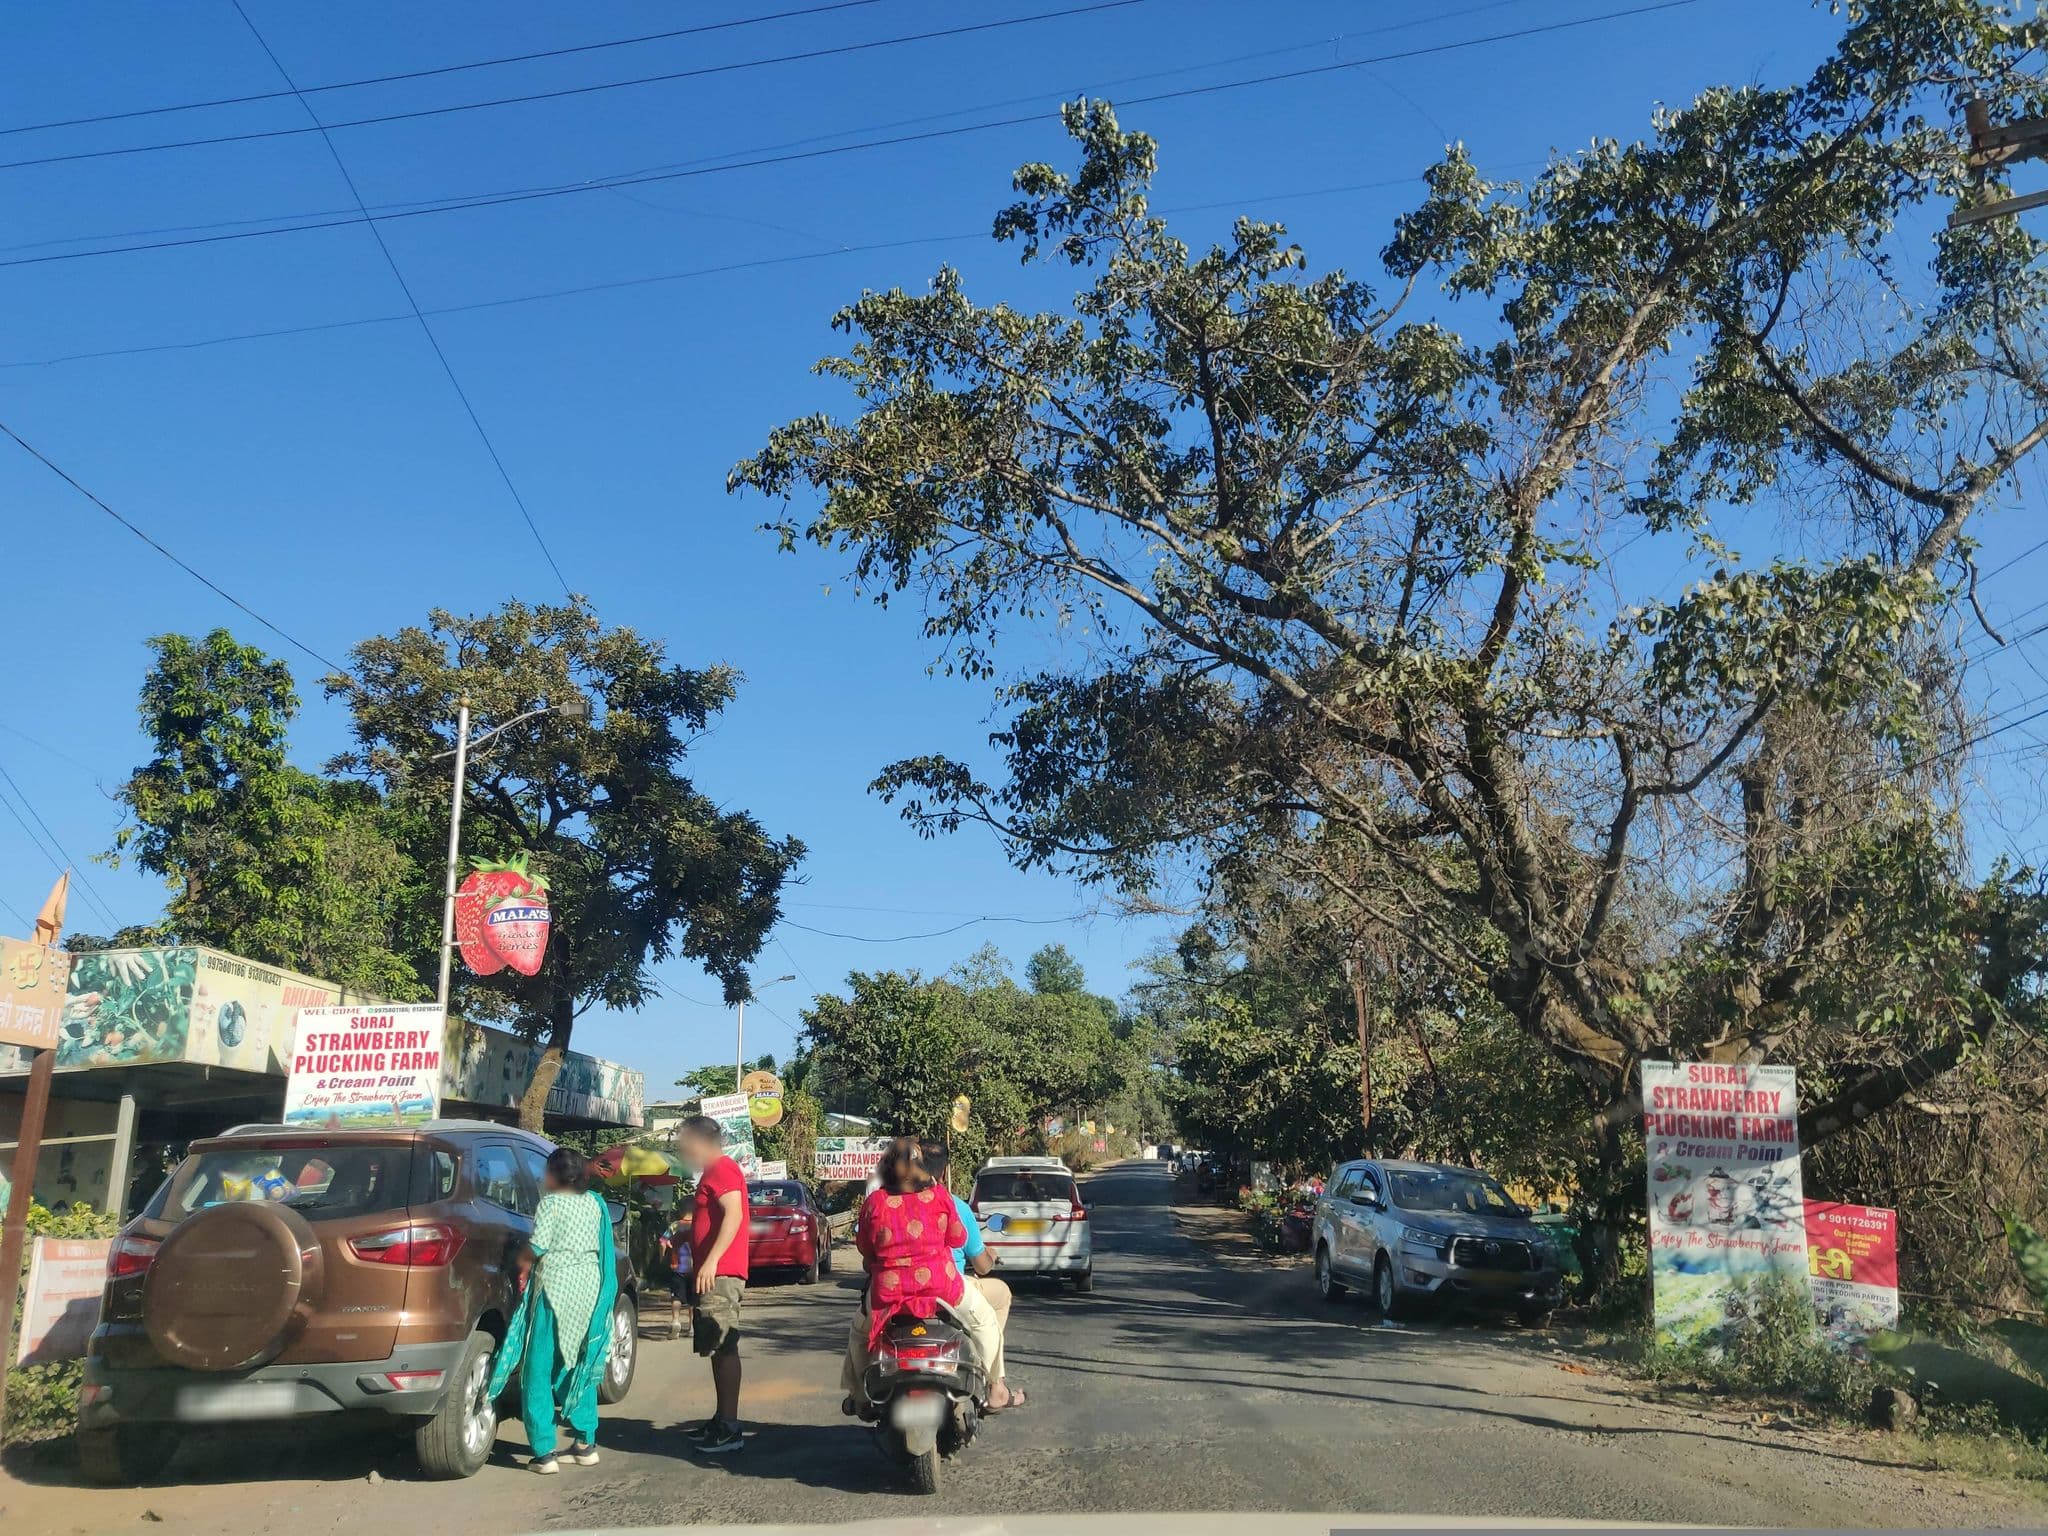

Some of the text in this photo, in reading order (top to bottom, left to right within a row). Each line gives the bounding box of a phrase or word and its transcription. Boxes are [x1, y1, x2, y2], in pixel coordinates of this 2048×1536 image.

[493, 909, 549, 923] MALA'S
[350, 1015, 394, 1029] SURAJ
[306, 1031, 430, 1052] STRAWBERRY
[294, 1051, 440, 1074] PLUCKING FARM
[316, 1075, 416, 1089] & Cream Point
[1688, 1065, 1747, 1085] SURAJ
[303, 1089, 423, 1107] Enjoy The Strawberry Farm
[703, 1095, 746, 1110] STRAWBERRY
[1652, 1086, 1781, 1114] STRAWBERRY
[1643, 1112, 1794, 1143] PLUCKING FARM
[816, 1152, 881, 1165] SURAJ STRAWBE
[1675, 1141, 1733, 1160] Cream
[1736, 1144, 1784, 1162] Point
[824, 1166, 863, 1178] PLUCKING
[1828, 1214, 1888, 1231] 9011726391
[1833, 1228, 1846, 1238] Our
[1651, 1230, 1802, 1255] Enjoy The Strawberry Farm
[1811, 1278, 1836, 1289] LOWER
